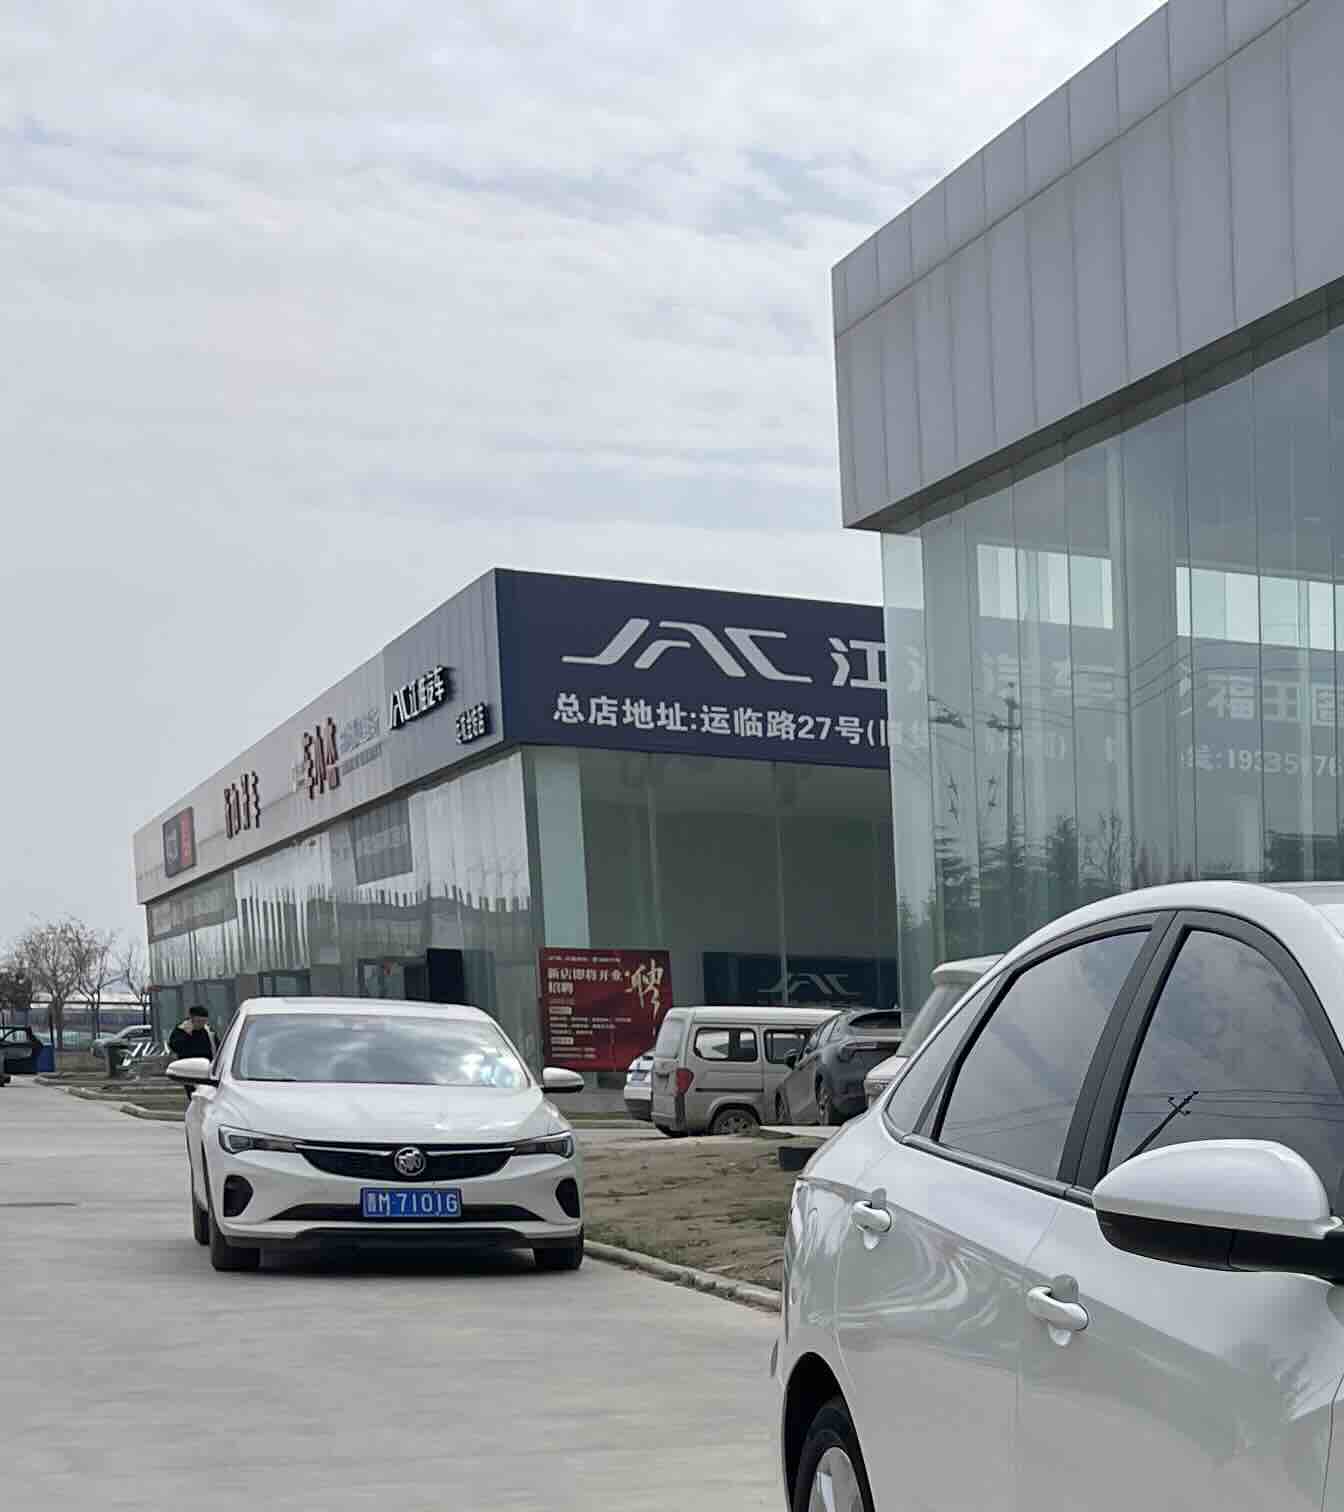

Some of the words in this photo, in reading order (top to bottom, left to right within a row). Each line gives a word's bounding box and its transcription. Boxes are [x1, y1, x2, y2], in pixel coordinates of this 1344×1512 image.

[561, 618, 813, 683] JAC
[553, 692, 888, 747] 总店地址:运临路27号(
